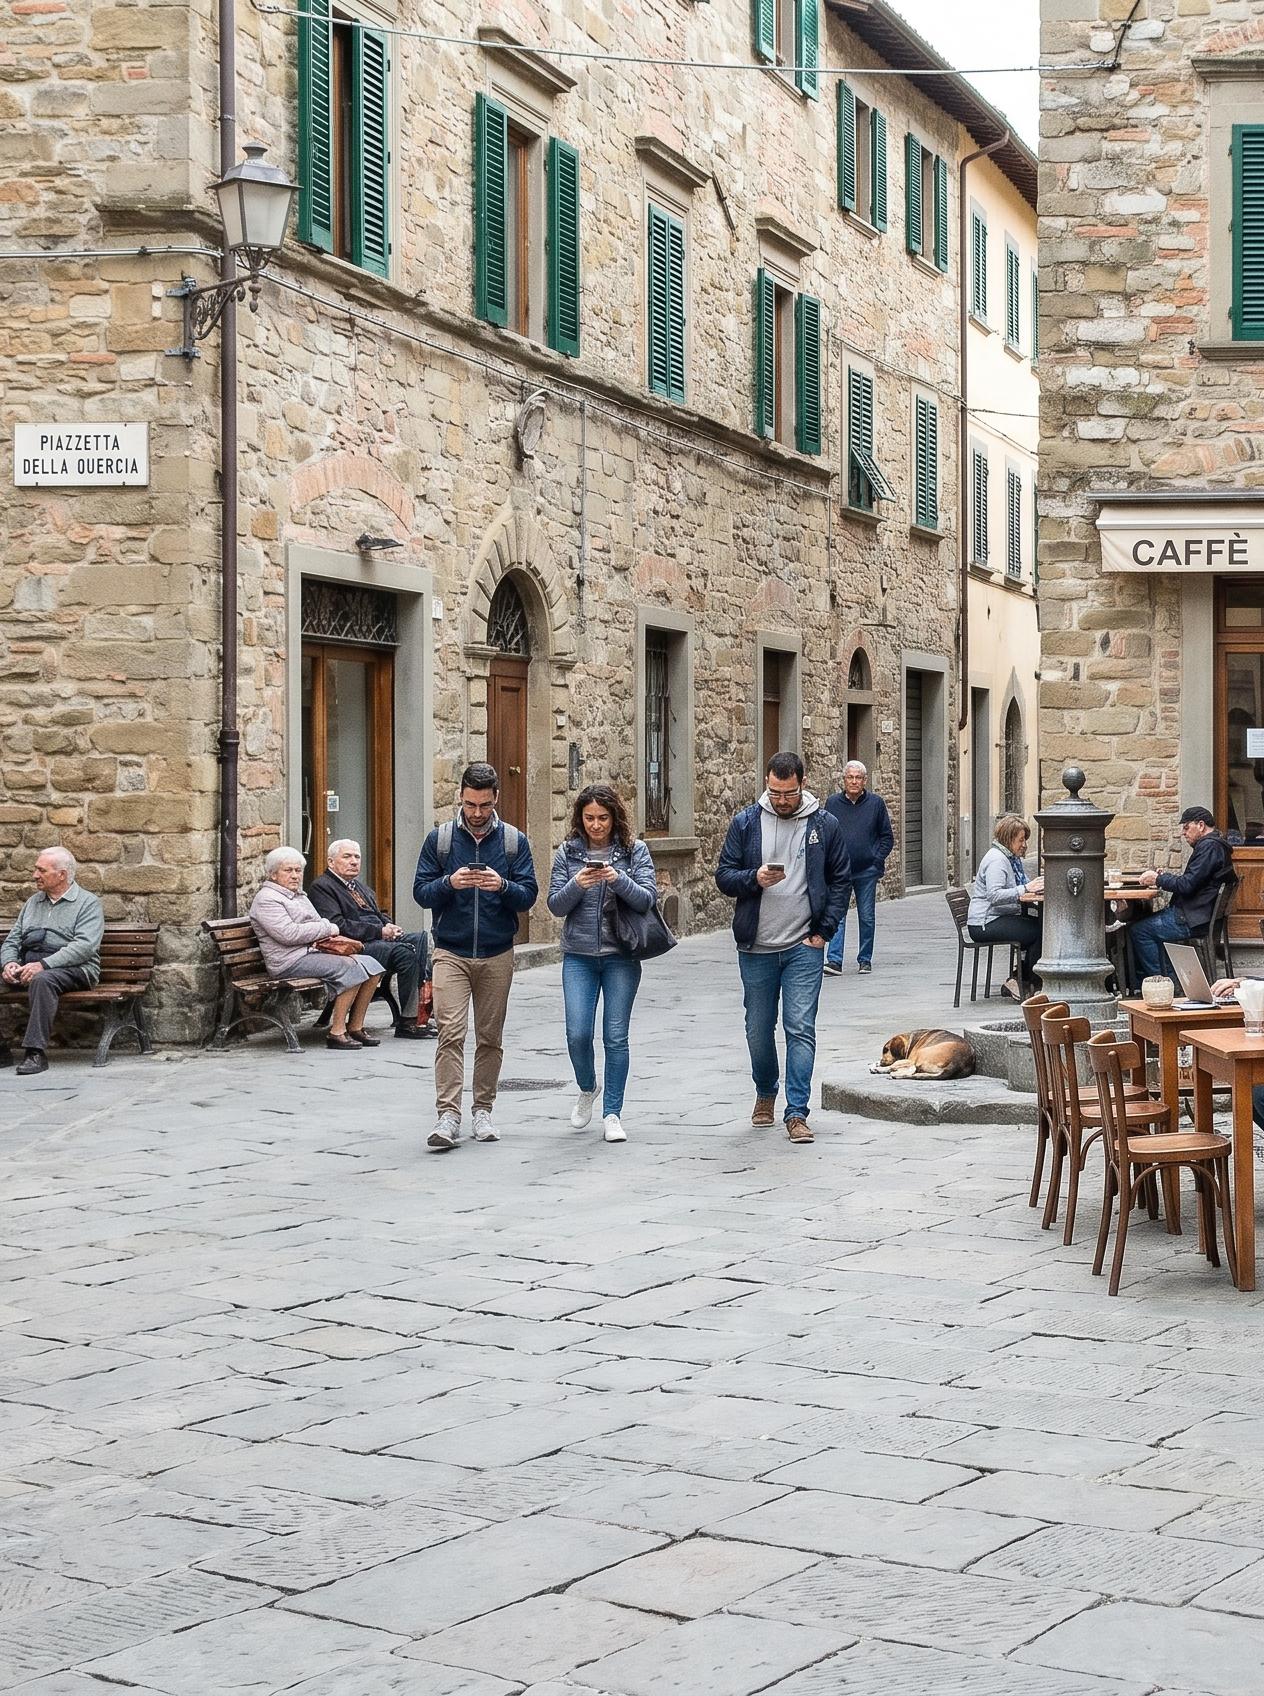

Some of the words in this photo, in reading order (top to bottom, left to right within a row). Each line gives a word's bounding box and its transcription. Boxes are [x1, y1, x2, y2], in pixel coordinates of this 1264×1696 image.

[40, 434, 120, 451] PIAZZETTA
[23, 458, 69, 475] DELLA
[1132, 532, 1249, 566] CAFFÈ
